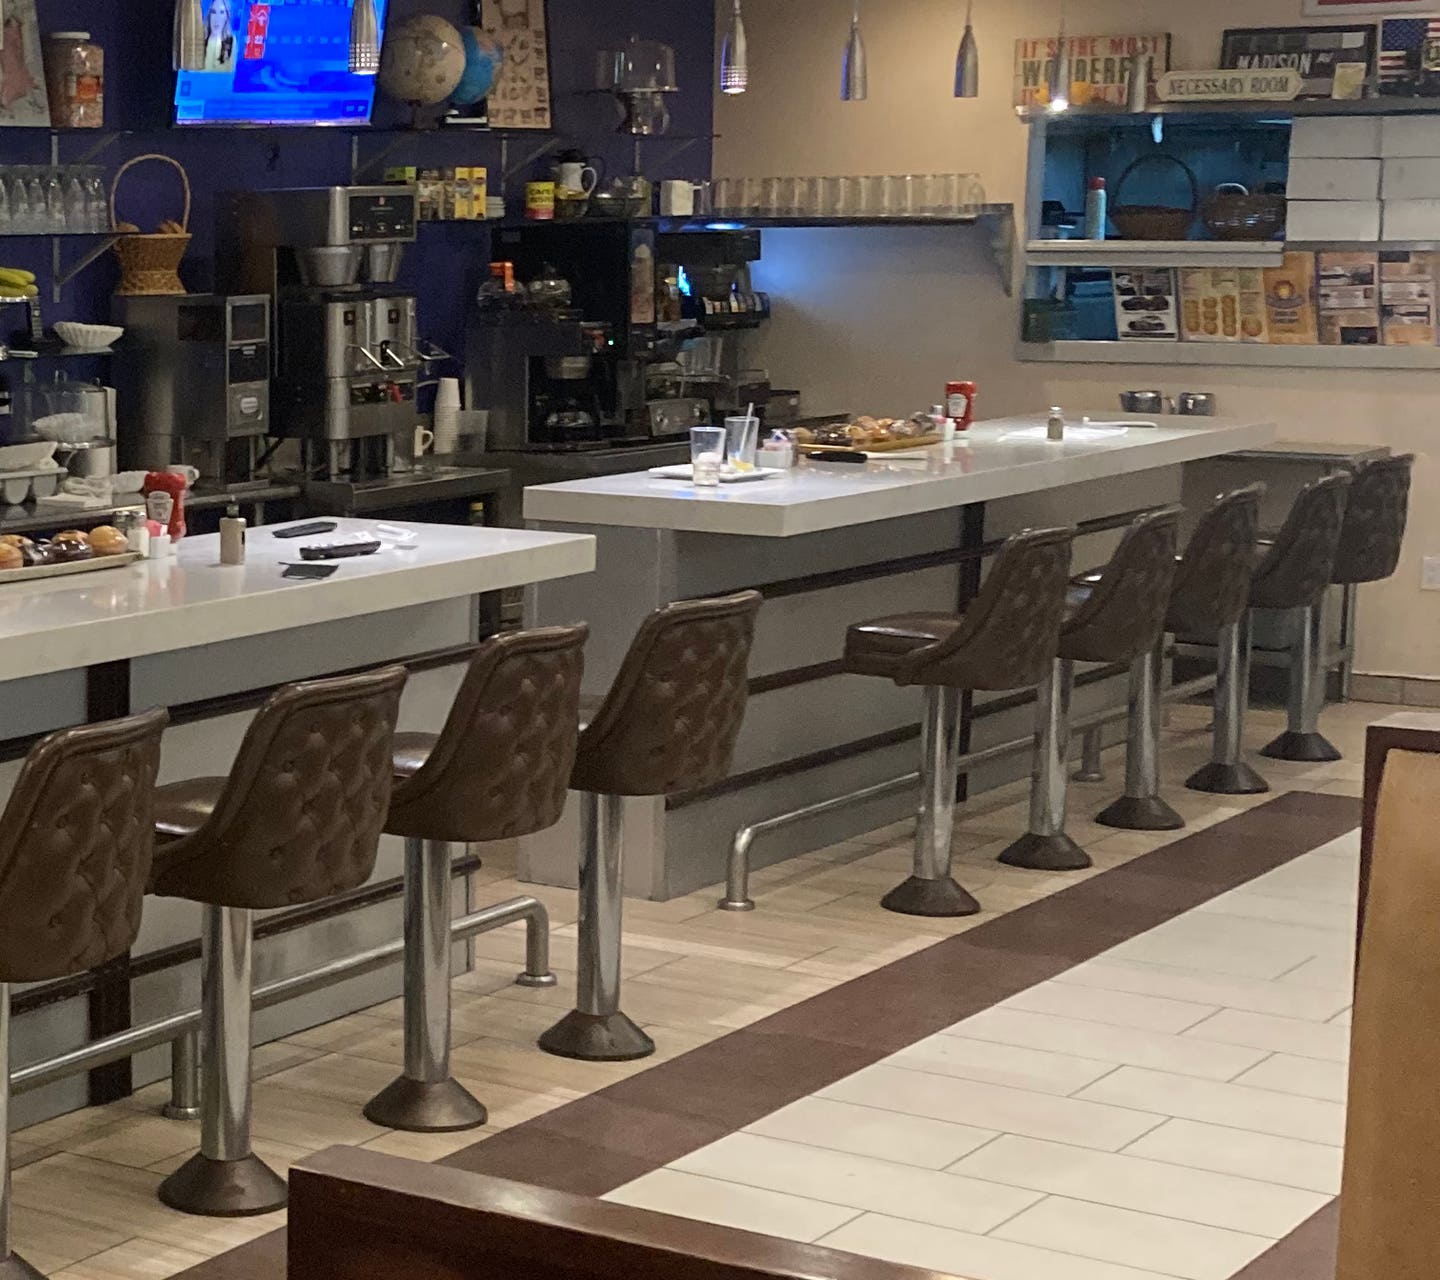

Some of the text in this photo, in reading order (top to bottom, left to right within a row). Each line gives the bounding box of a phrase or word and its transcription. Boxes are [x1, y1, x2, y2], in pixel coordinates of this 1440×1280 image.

[1110, 36, 1158, 56] MOST
[1237, 51, 1311, 75] MADISON
[1168, 75, 1289, 96] NECESSARY ROOM
